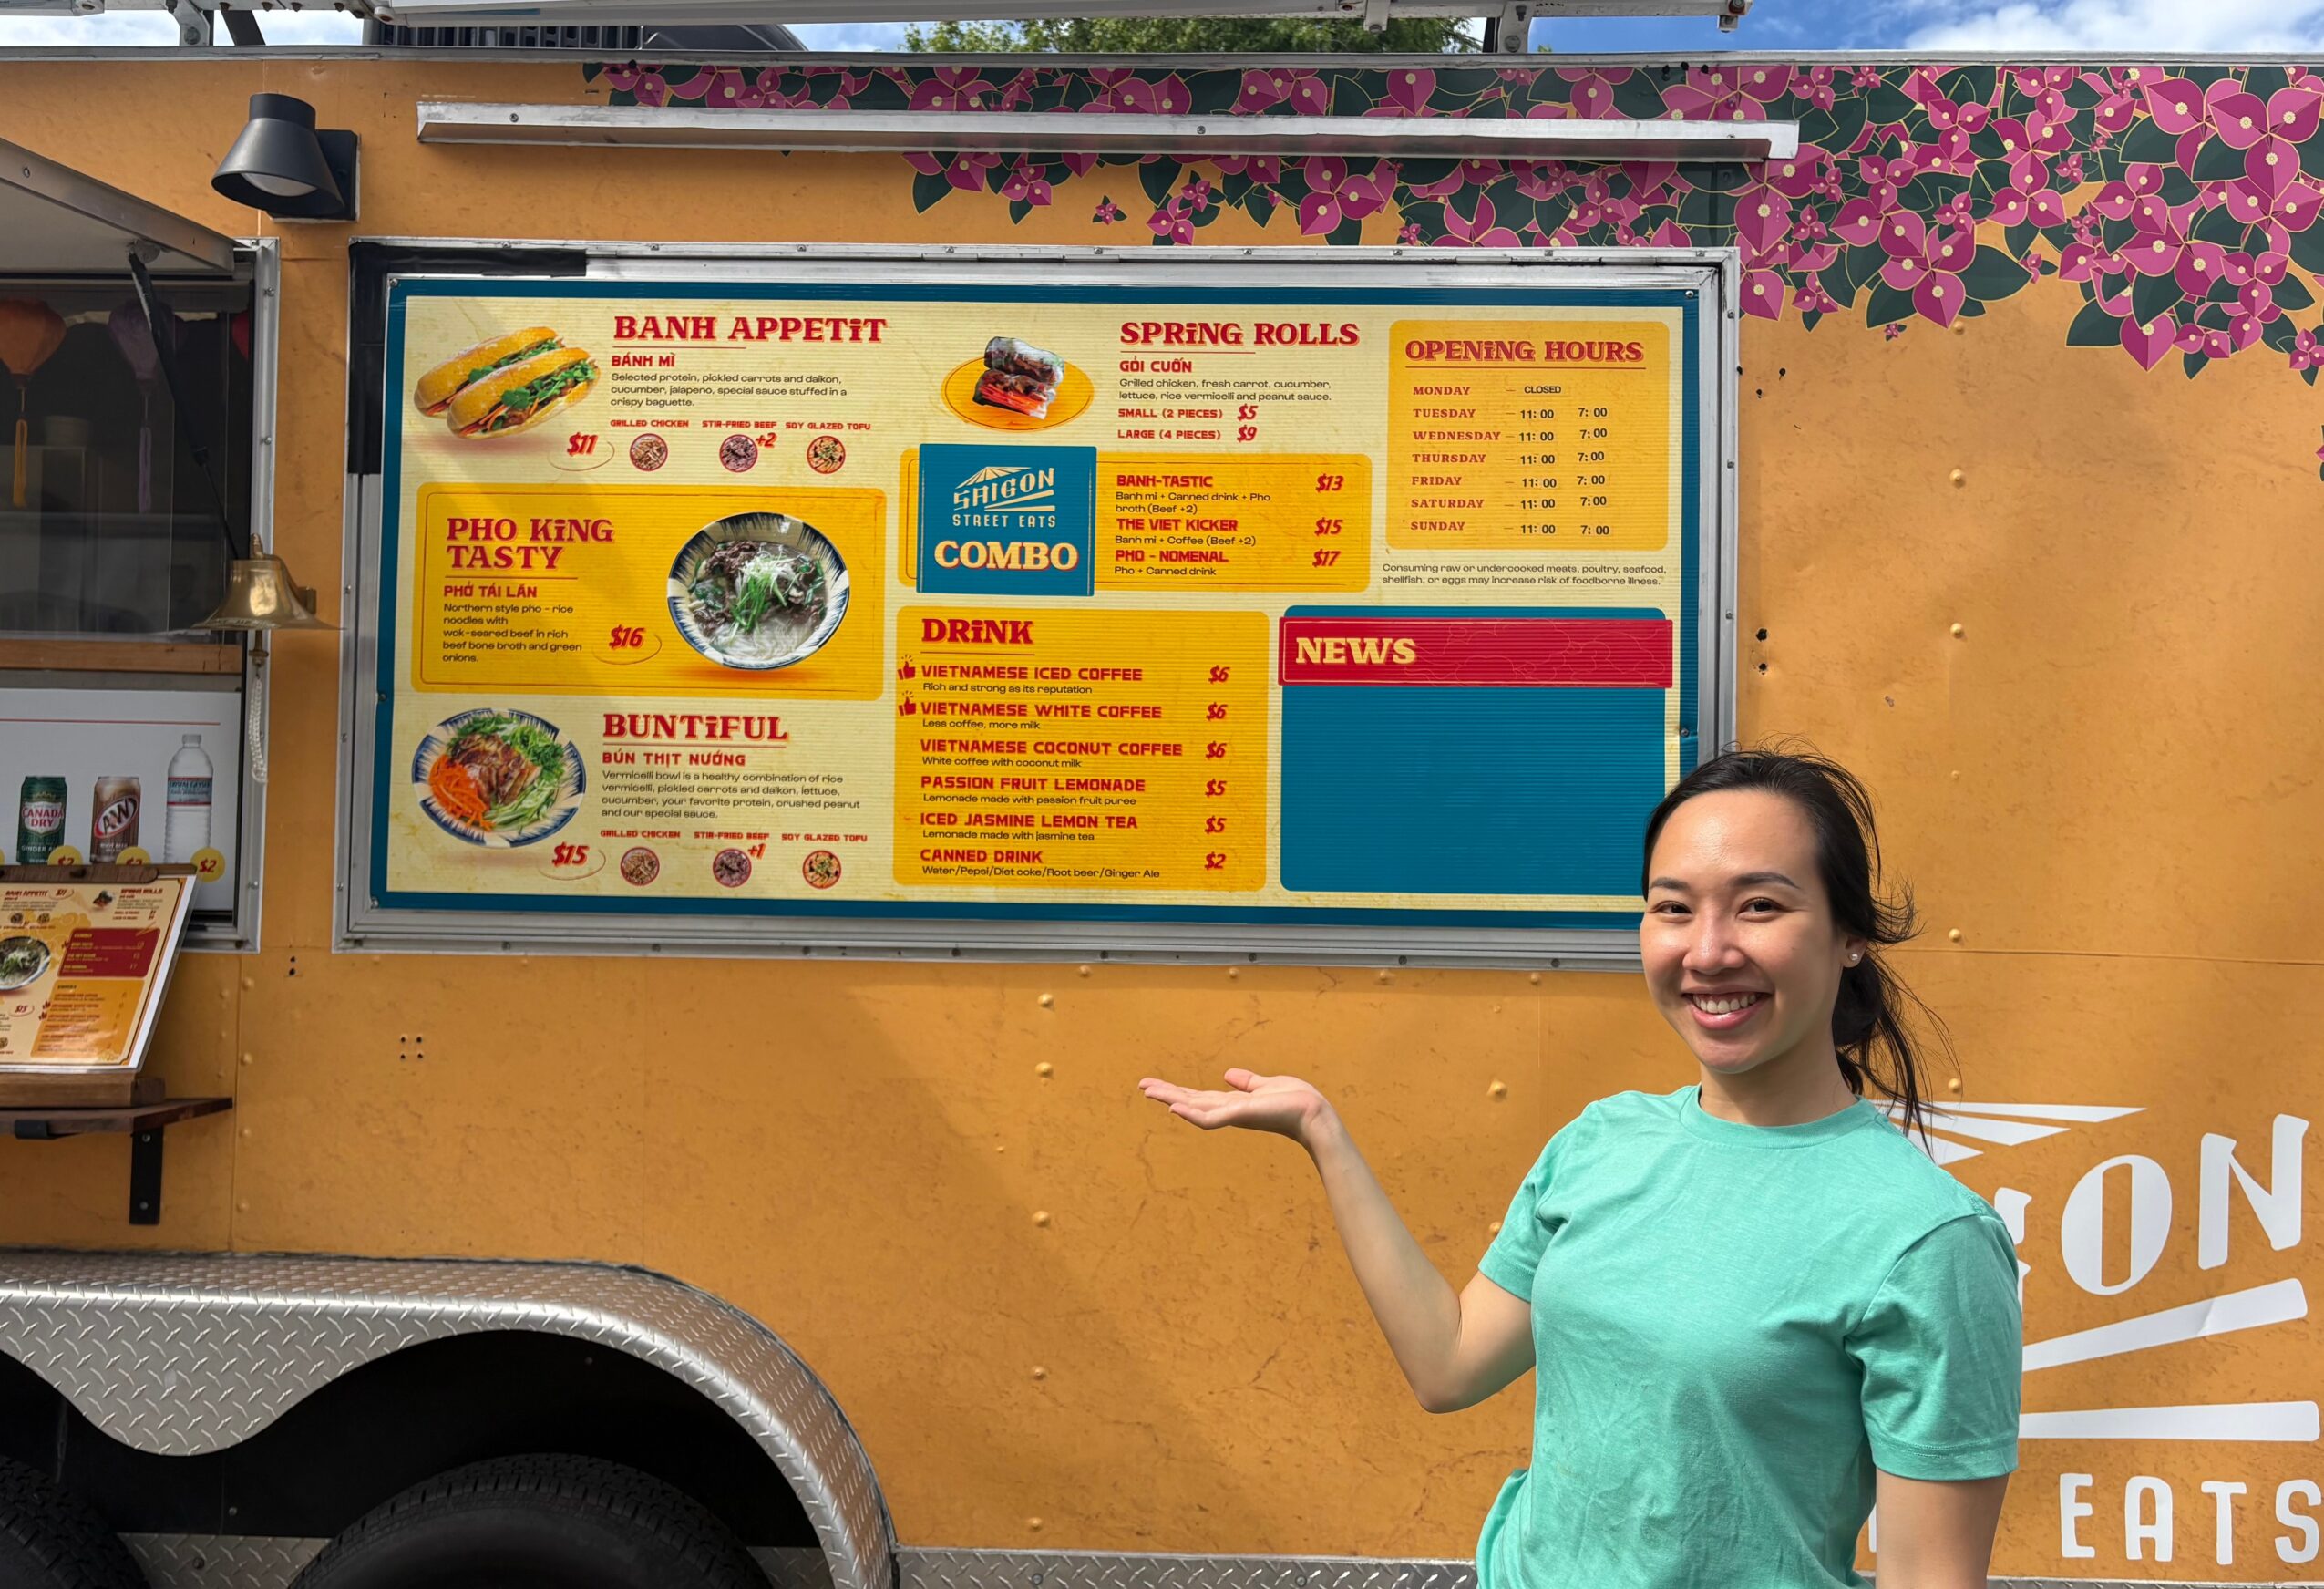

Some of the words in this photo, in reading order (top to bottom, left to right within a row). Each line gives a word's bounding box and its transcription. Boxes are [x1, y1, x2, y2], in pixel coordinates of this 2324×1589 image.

[613, 315, 716, 340] BANH
[1253, 323, 1359, 346] ROLLS
[612, 352, 653, 366] BÁNH
[658, 352, 674, 366] MÌ
[1544, 341, 1644, 362] HOURS
[611, 372, 657, 381] Selected
[659, 373, 700, 383] protein,
[702, 373, 739, 384] pickled
[740, 375, 782, 383] carrots
[783, 375, 803, 383] and
[805, 375, 841, 385] daikon,
[1119, 378, 1154, 387] Grilled
[1156, 378, 1198, 387] chicken,
[1201, 379, 1231, 387] fresh
[1232, 380, 1271, 388] carrot,
[1273, 379, 1331, 388] cucumber,
[611, 386, 667, 394] cucumber,
[669, 386, 715, 396] jalapeno,
[717, 387, 754, 396] special
[755, 387, 787, 396] sauce
[789, 387, 828, 396] stuffed
[828, 387, 838, 396] in
[1119, 390, 1157, 400] lettuce,
[1160, 391, 1182, 400] rice
[1184, 392, 1235, 400] vermicelli
[1236, 392, 1256, 400] and
[1258, 393, 1295, 402] peanut
[1413, 386, 1470, 395] MONDAY
[1524, 386, 1562, 394] CLOSED
[610, 397, 643, 408] crispy
[645, 397, 694, 408] baguette.
[1118, 408, 1157, 418] SMALL
[1177, 408, 1223, 418] PIECES)
[1237, 403, 1259, 421] $5
[1413, 408, 1476, 418] TUESDAY
[1117, 429, 1155, 439] LARGE
[1176, 430, 1221, 440] PIECES)
[1237, 425, 1258, 442] $9
[1413, 431, 1501, 440] WEDNESDAY
[566, 431, 598, 456] $11
[1412, 453, 1486, 463] THURSDAY
[1116, 474, 1213, 488] BANH-TASTIC
[1315, 473, 1344, 492] $13
[953, 467, 1055, 511] SAIGON
[1411, 499, 1484, 508] SATURDAY
[952, 514, 1008, 527] STREET
[1019, 515, 1055, 528] EATS
[1116, 518, 1145, 531] THE
[1148, 518, 1181, 531] VIET
[1186, 519, 1238, 531] KICKER
[1314, 518, 1343, 536] $15
[1410, 521, 1465, 531] SUNDAY
[447, 517, 517, 542] PHO
[446, 545, 563, 569] TASTY
[934, 540, 1077, 570] COMBO
[1116, 549, 1145, 562] PHO
[1159, 550, 1229, 562] NOMENAL
[1312, 549, 1342, 567] $17
[1382, 563, 1439, 573] Consuming
[1476, 563, 1544, 573] undercooked
[1546, 564, 1579, 573] meats,
[1581, 565, 1620, 574] poultry,
[1622, 565, 1667, 574] seafood,
[1382, 575, 1425, 583] shellfish,
[1441, 577, 1466, 585] eggs
[1468, 577, 1490, 585] may
[1491, 575, 1537, 583] increase
[1537, 576, 1558, 584] risk
[1558, 576, 1570, 584] of
[1571, 576, 1626, 585] foodborne
[1628, 576, 1661, 585] illness.
[443, 616, 484, 624] noodles
[486, 616, 508, 624] with
[443, 628, 509, 637] wok-seared
[509, 629, 534, 638] beef
[536, 629, 545, 638] in
[547, 629, 568, 638] rich
[609, 624, 645, 649] $16
[442, 641, 467, 649] beef
[468, 641, 495, 650] bone
[496, 642, 527, 650] broth
[529, 642, 548, 651] and
[550, 644, 581, 652] green
[1295, 637, 1416, 665] NEWS
[921, 665, 1028, 679] VIETNAMESE
[1034, 667, 1072, 680] ICED
[1077, 667, 1143, 681] COFFEE
[1208, 665, 1230, 684] $6
[920, 702, 1027, 717] VIETNAMESE
[1034, 704, 1091, 717] WHITE
[1097, 705, 1161, 718] COFFEE
[1206, 702, 1228, 721] $6
[922, 718, 947, 727] Less
[949, 719, 986, 729] coffee,
[988, 721, 1018, 729] more
[1020, 720, 1040, 729] milk
[920, 738, 1026, 754] VIETNAMESE
[1033, 741, 1112, 755] COCONUT
[1118, 742, 1182, 756] COFFEE
[1205, 740, 1227, 759] $6
[602, 748, 635, 764] BÚN
[643, 752, 682, 768] THỊT
[920, 776, 994, 789] PASSION
[1000, 777, 1048, 790] FRUIT
[1054, 778, 1146, 792] LEMONADE
[1205, 779, 1227, 797] $5
[22, 807, 64, 819] CANADA
[920, 812, 958, 826] ICED
[964, 813, 1034, 827] JASMINE
[1041, 815, 1098, 828] LEMON
[1105, 816, 1137, 829] TEA
[31, 819, 54, 828] DRY
[1205, 815, 1227, 834] $5
[551, 842, 589, 867] $15
[920, 849, 987, 862] CANNED
[993, 850, 1043, 863] DRINK
[1204, 851, 1227, 871] $2
[199, 858, 217, 873] $2
[2060, 1473, 2322, 1564] EATS
